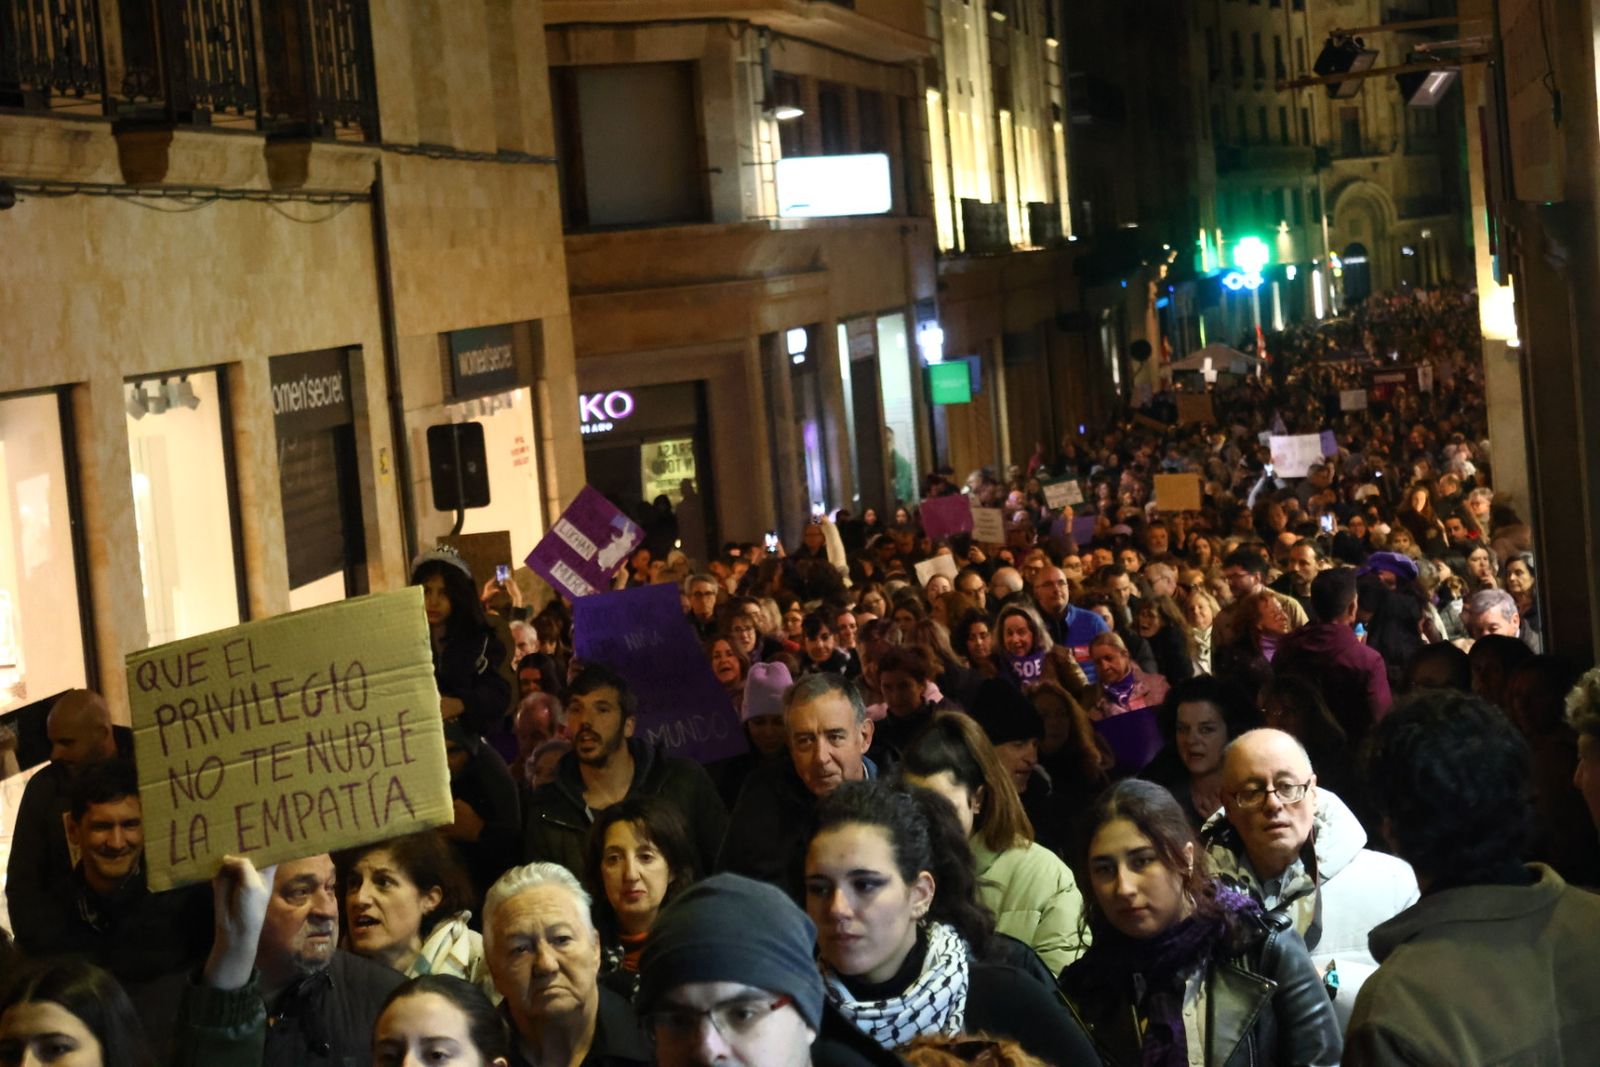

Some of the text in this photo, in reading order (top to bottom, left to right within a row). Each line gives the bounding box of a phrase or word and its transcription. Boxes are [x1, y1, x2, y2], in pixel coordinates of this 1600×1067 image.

[136, 638, 271, 694] QUE EL
[154, 660, 369, 757] PRIVILEGIO
[167, 709, 416, 809] NO TE NUBLE
[646, 712, 729, 749] MUNDO
[168, 772, 416, 866] LA EMPATÍA
